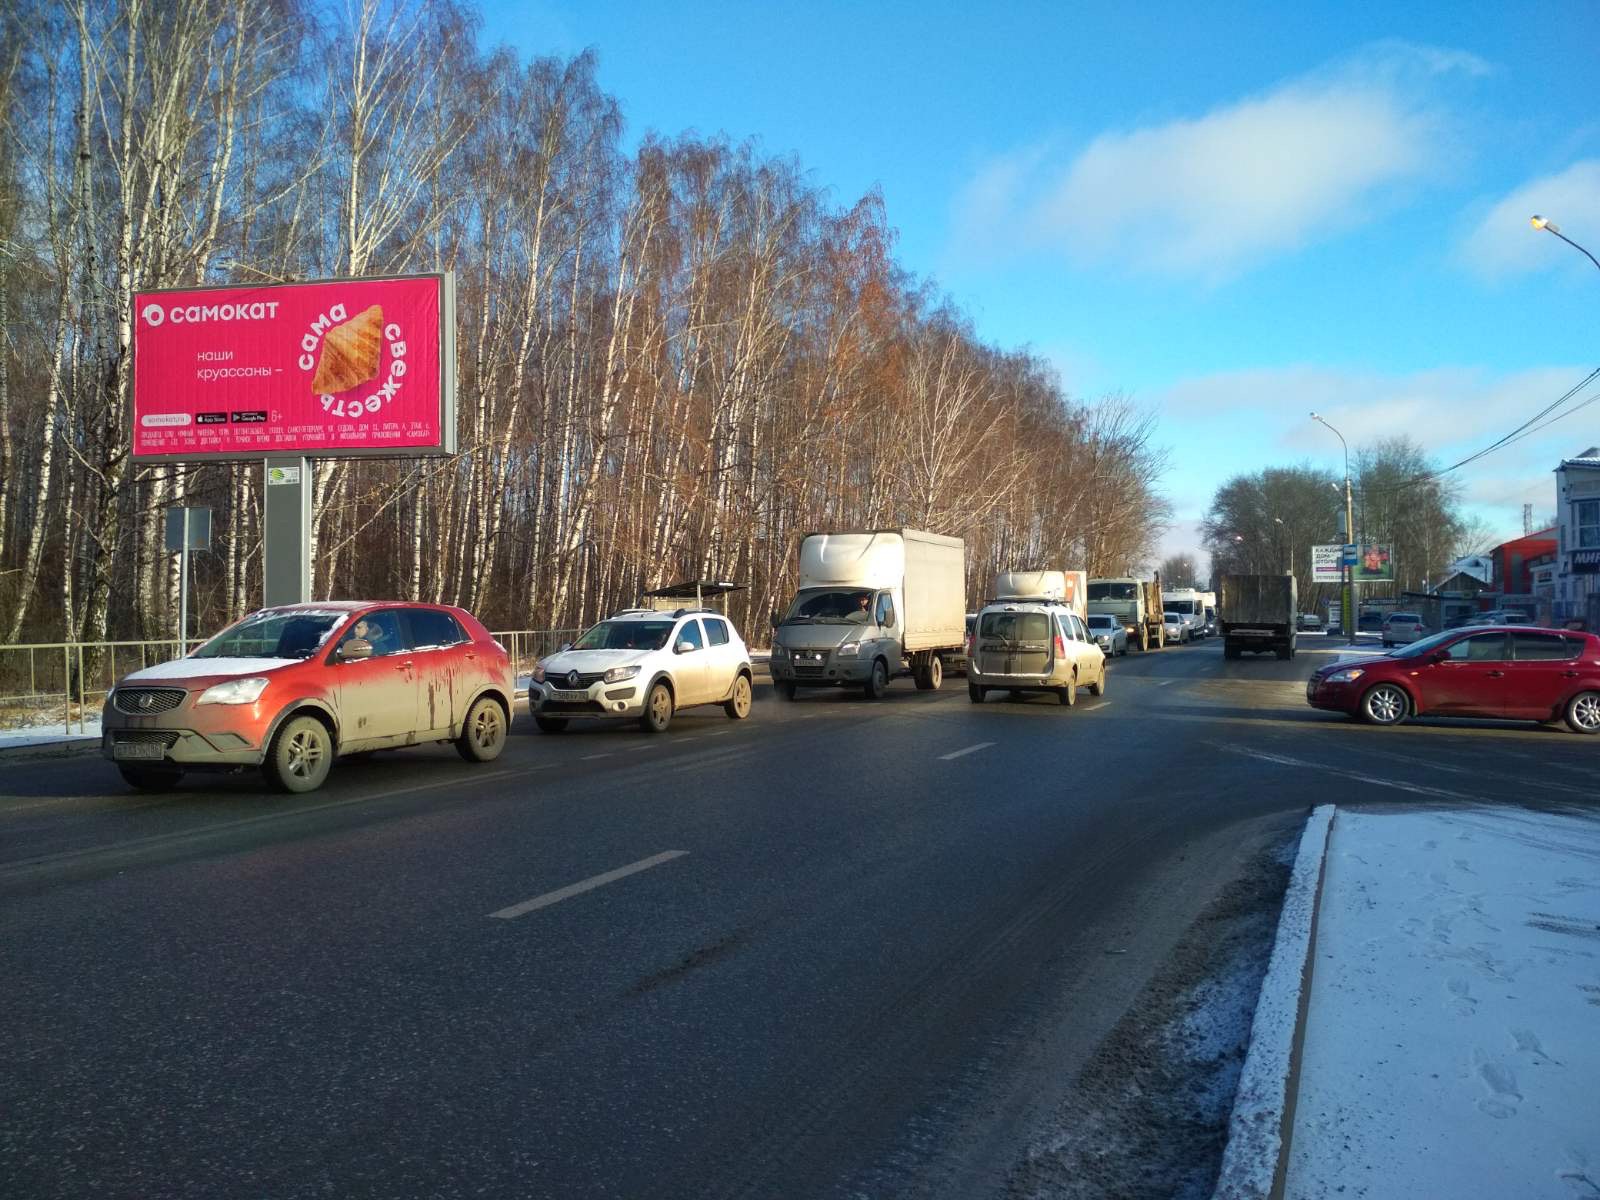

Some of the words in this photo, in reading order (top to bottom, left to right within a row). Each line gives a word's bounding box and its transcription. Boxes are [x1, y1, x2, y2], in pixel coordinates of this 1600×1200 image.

[170, 302, 279, 324] самокат
[298, 303, 347, 371] сама
[197, 351, 233, 361] наши
[197, 367, 272, 381] круассаны
[320, 323, 407, 418] свежесть
